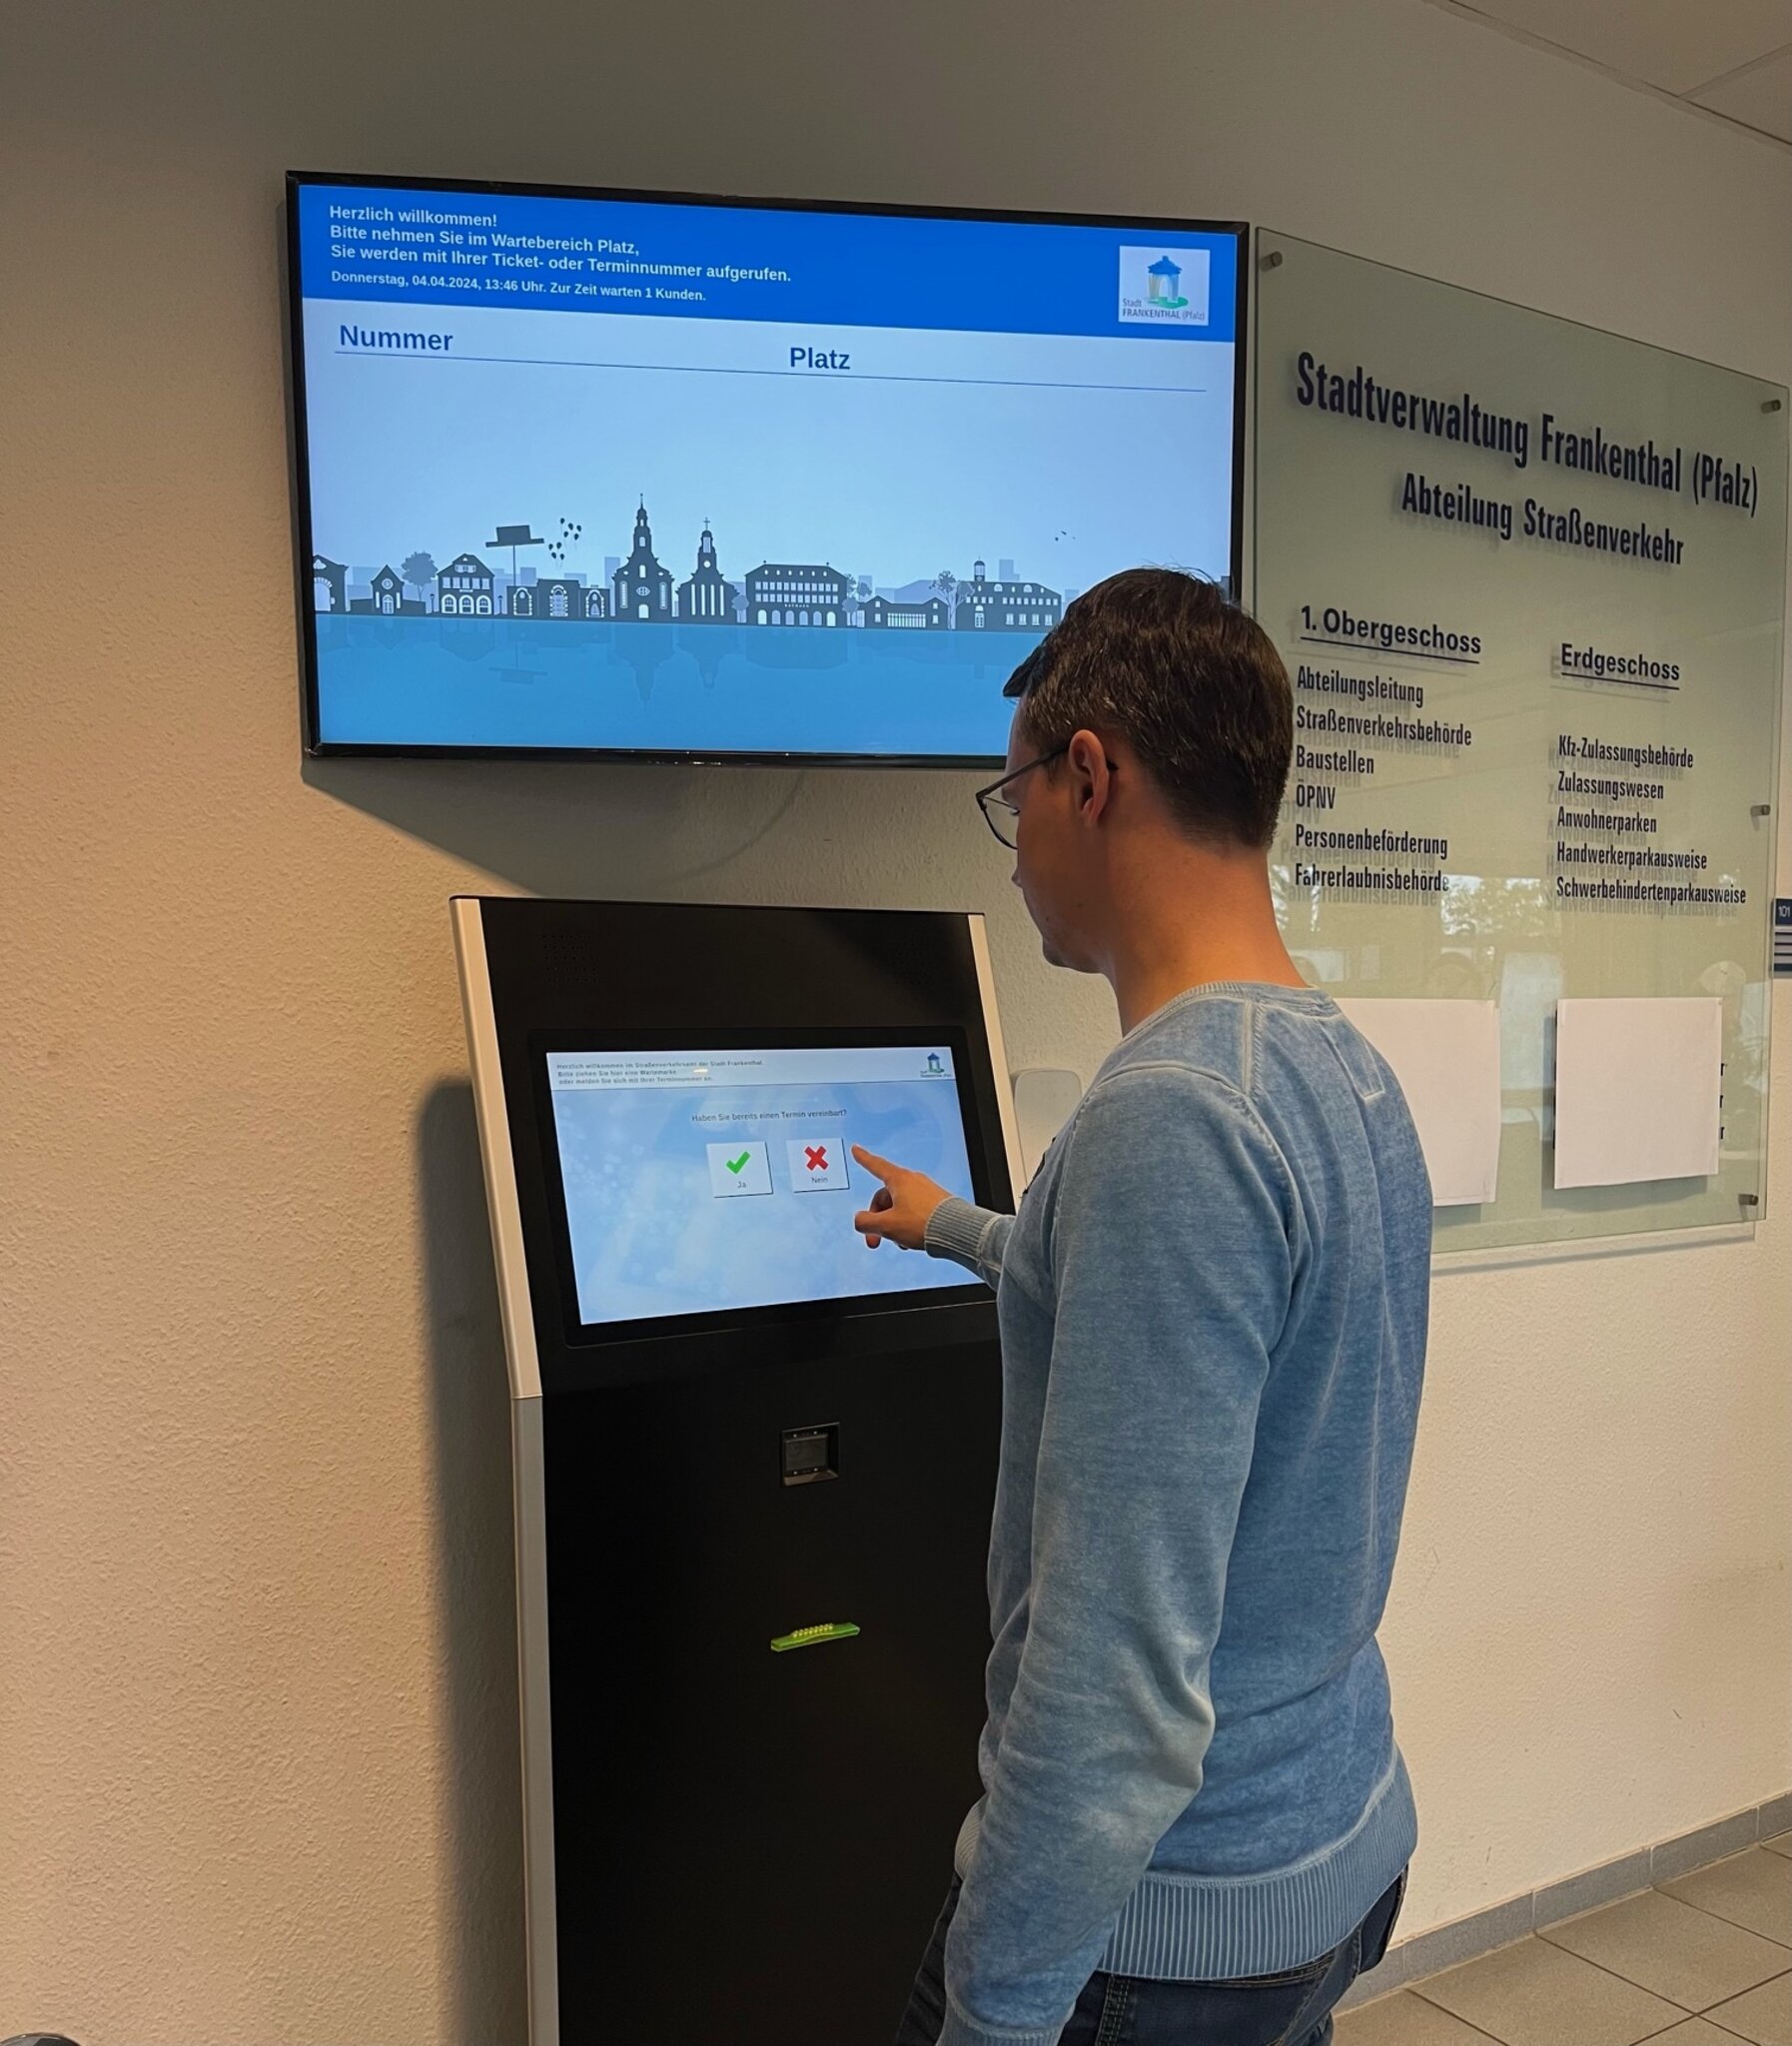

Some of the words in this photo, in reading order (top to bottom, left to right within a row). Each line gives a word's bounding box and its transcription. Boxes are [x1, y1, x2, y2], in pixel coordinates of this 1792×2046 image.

[330, 205, 394, 222] Herzlich
[398, 209, 498, 228] willkommen!
[330, 225, 368, 240] Bitte
[372, 227, 435, 243] nehmen
[440, 230, 464, 246] Sie
[468, 232, 487, 247] im
[491, 233, 593, 252] Wartebereich
[597, 239, 639, 257] Platz,
[331, 244, 356, 258] Sie
[361, 247, 418, 263] werden
[423, 249, 448, 264] mit
[451, 250, 487, 266] Ihrer
[492, 252, 544, 268] Ticket-
[548, 257, 583, 271] oder
[587, 258, 702, 277] Terminnummer
[706, 265, 791, 283] aufgerufen.
[331, 270, 410, 288] Donnerstag,
[412, 275, 481, 291] 04.04.2024,
[484, 278, 518, 292] 13:46
[521, 281, 547, 294] Uhr.
[550, 282, 570, 295] Zur
[574, 283, 597, 296] Zeit
[600, 286, 642, 298] warten
[645, 287, 652, 299] 1
[655, 287, 706, 302] Kunden.
[1122, 298, 1142, 308] Stadt
[1122, 308, 1181, 319] FRANKENTHAL
[1182, 311, 1206, 321] (Pfalz)
[340, 325, 453, 353] Nummer
[790, 346, 851, 372] Platz
[1297, 351, 1528, 470] Stadtverwaltung
[1541, 413, 1682, 493] Frankenthal
[1692, 452, 1758, 518] (Pfalz)
[1400, 472, 1513, 540] Abteilung
[1523, 499, 1685, 565] Straßenverkehr
[1301, 605, 1318, 631] 1.
[1323, 606, 1482, 655] Obergeschoss
[1560, 642, 1681, 681] Erdgeschoss
[1297, 664, 1424, 709] Abteilungsleitung
[1297, 704, 1472, 746] Straßenverkehrsbehörde
[1296, 744, 1374, 774] Baustellen
[1558, 734, 1694, 768] Kfz-Zulassungsbehörde
[1296, 778, 1337, 810] ÖPNV
[1557, 770, 1665, 801] Zulassungswesen
[1557, 805, 1657, 836] Anwohnerparken
[1295, 823, 1448, 860] Personenbeförderung
[1557, 840, 1708, 871] Handwerkerparkausweise
[1295, 862, 1449, 892] Fahrerlaubnisbehörde
[1556, 875, 1747, 906] Schwerbehindertenparkausweise
[718, 1113, 730, 1122] Sie
[732, 1112, 758, 1121] bereits
[781, 1111, 806, 1120] Termin
[807, 1109, 848, 1118] vereinbart?
[811, 1176, 829, 1185] Nein
